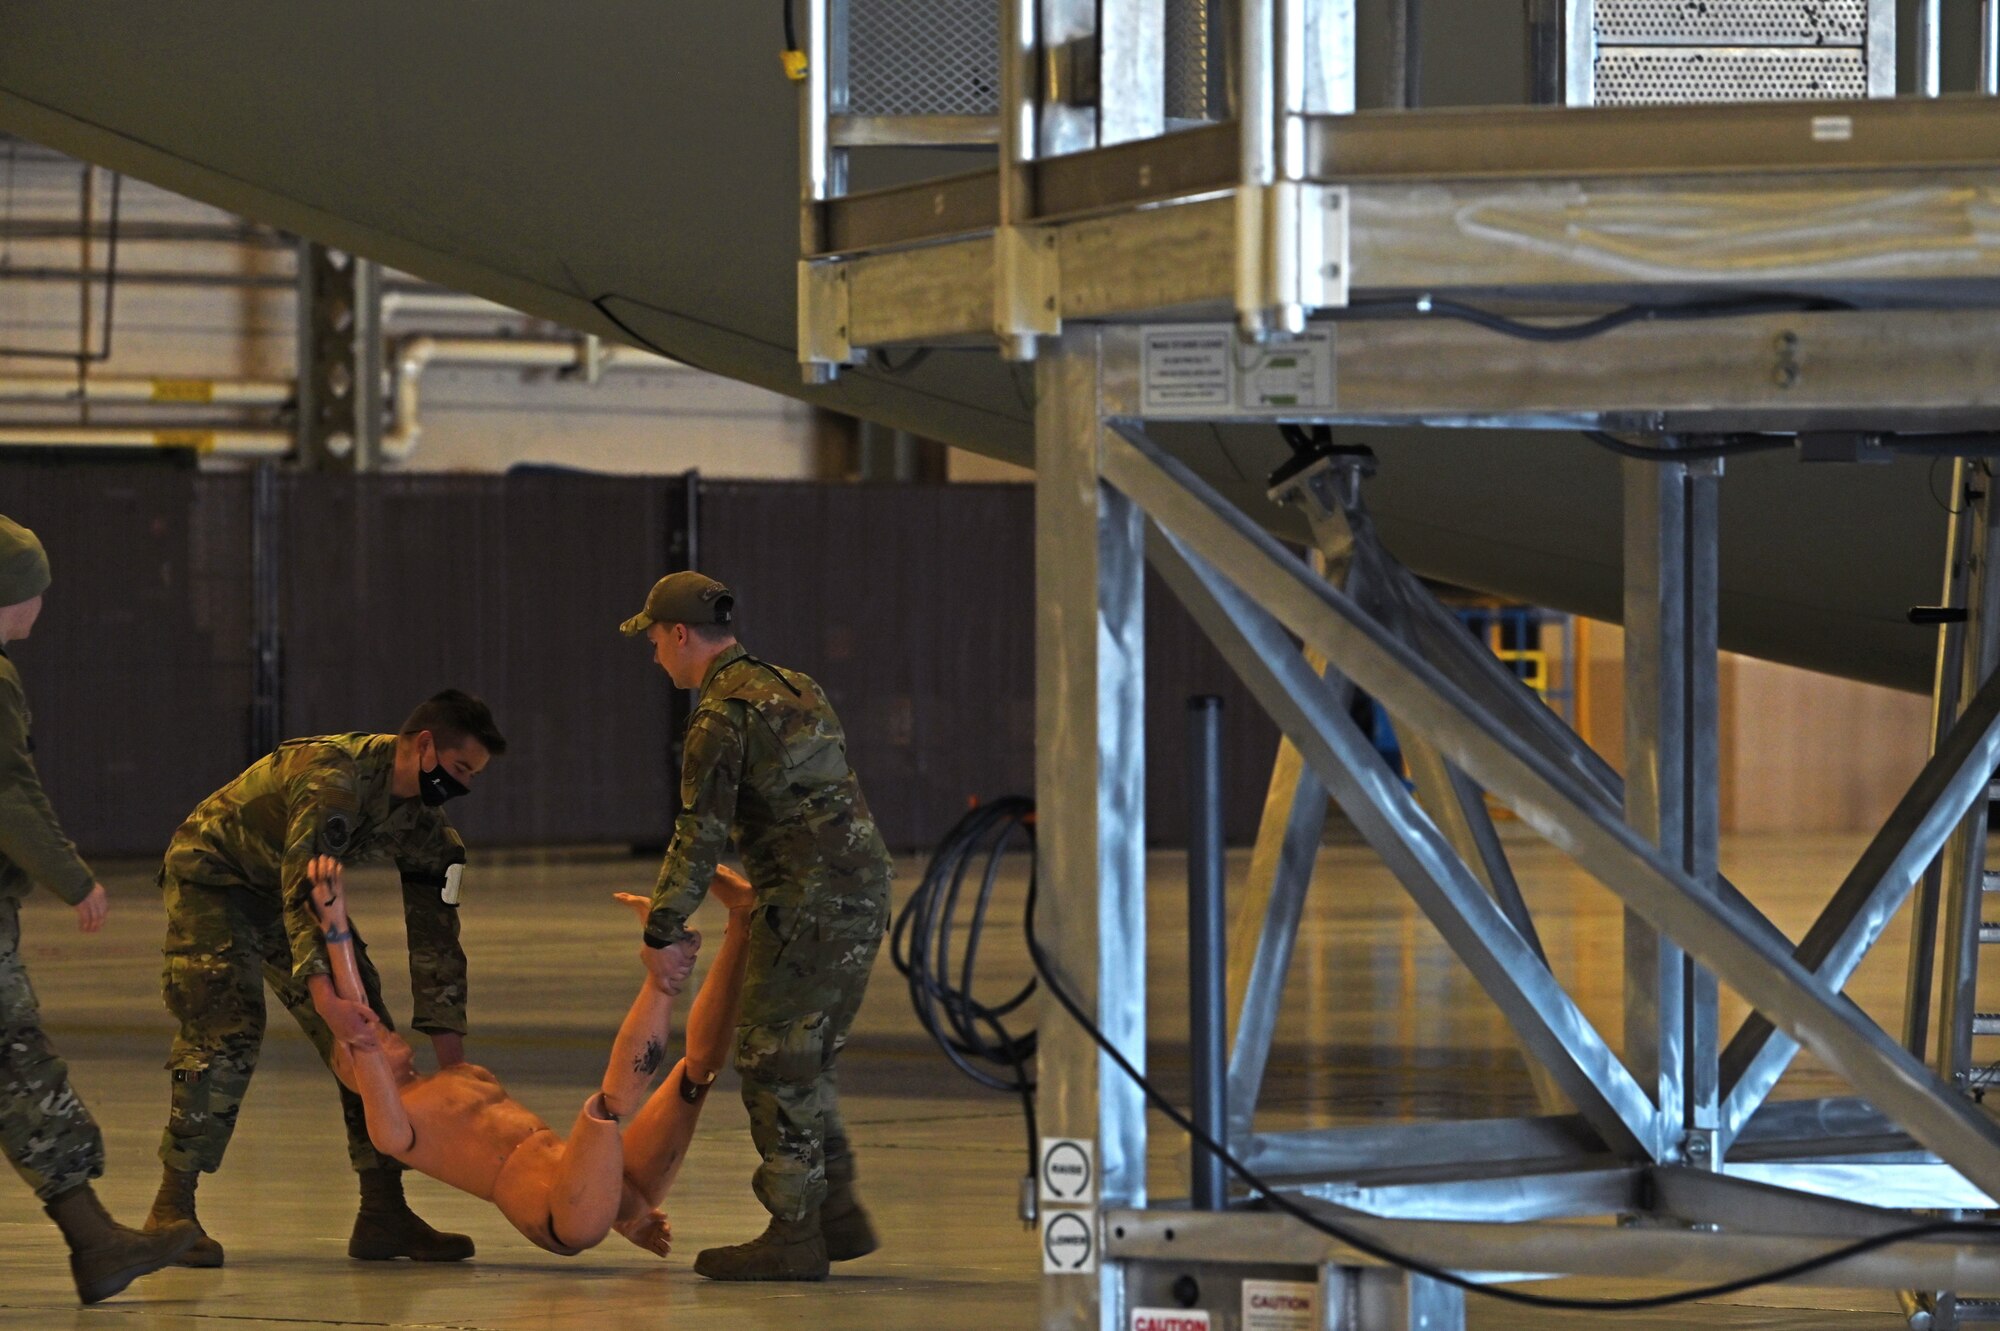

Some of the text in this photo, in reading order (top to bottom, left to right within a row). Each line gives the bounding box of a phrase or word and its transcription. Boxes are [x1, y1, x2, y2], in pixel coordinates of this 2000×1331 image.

[1051, 1163, 1082, 1175] RAISE
[1049, 1235, 1087, 1246] LOWER
[1251, 1294, 1310, 1311] CAUTION
[1135, 1316, 1208, 1331] CAUTION
